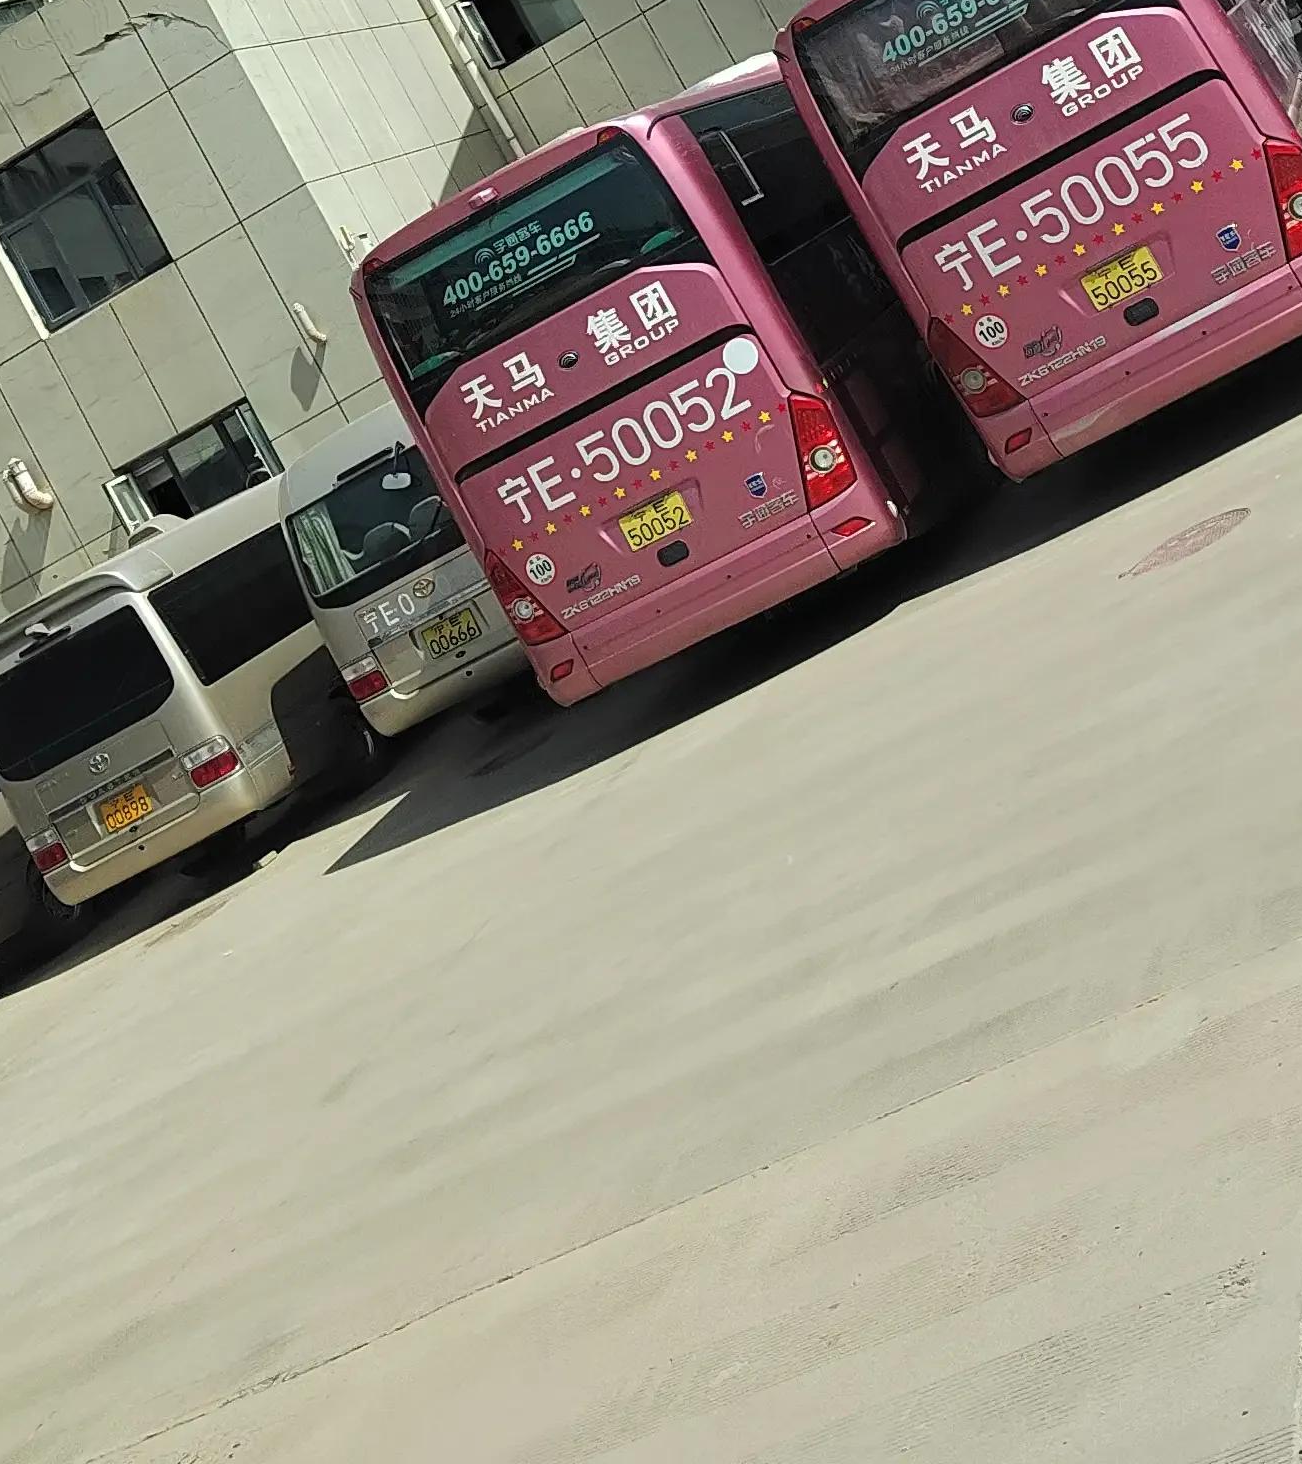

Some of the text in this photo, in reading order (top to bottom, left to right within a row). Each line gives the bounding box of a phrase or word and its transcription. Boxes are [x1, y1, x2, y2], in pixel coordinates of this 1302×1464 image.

[918, 64, 1144, 194] TIANMA GROUP
[443, 211, 594, 307] 400-659-6666
[1091, 261, 1158, 306] 50055
[979, 322, 1005, 345] 100
[475, 318, 679, 434] TIANMA GROUP
[627, 507, 689, 547] 50052
[529, 561, 553, 581] 100
[429, 620, 477, 655] 00666
[106, 796, 149, 829] 00898
